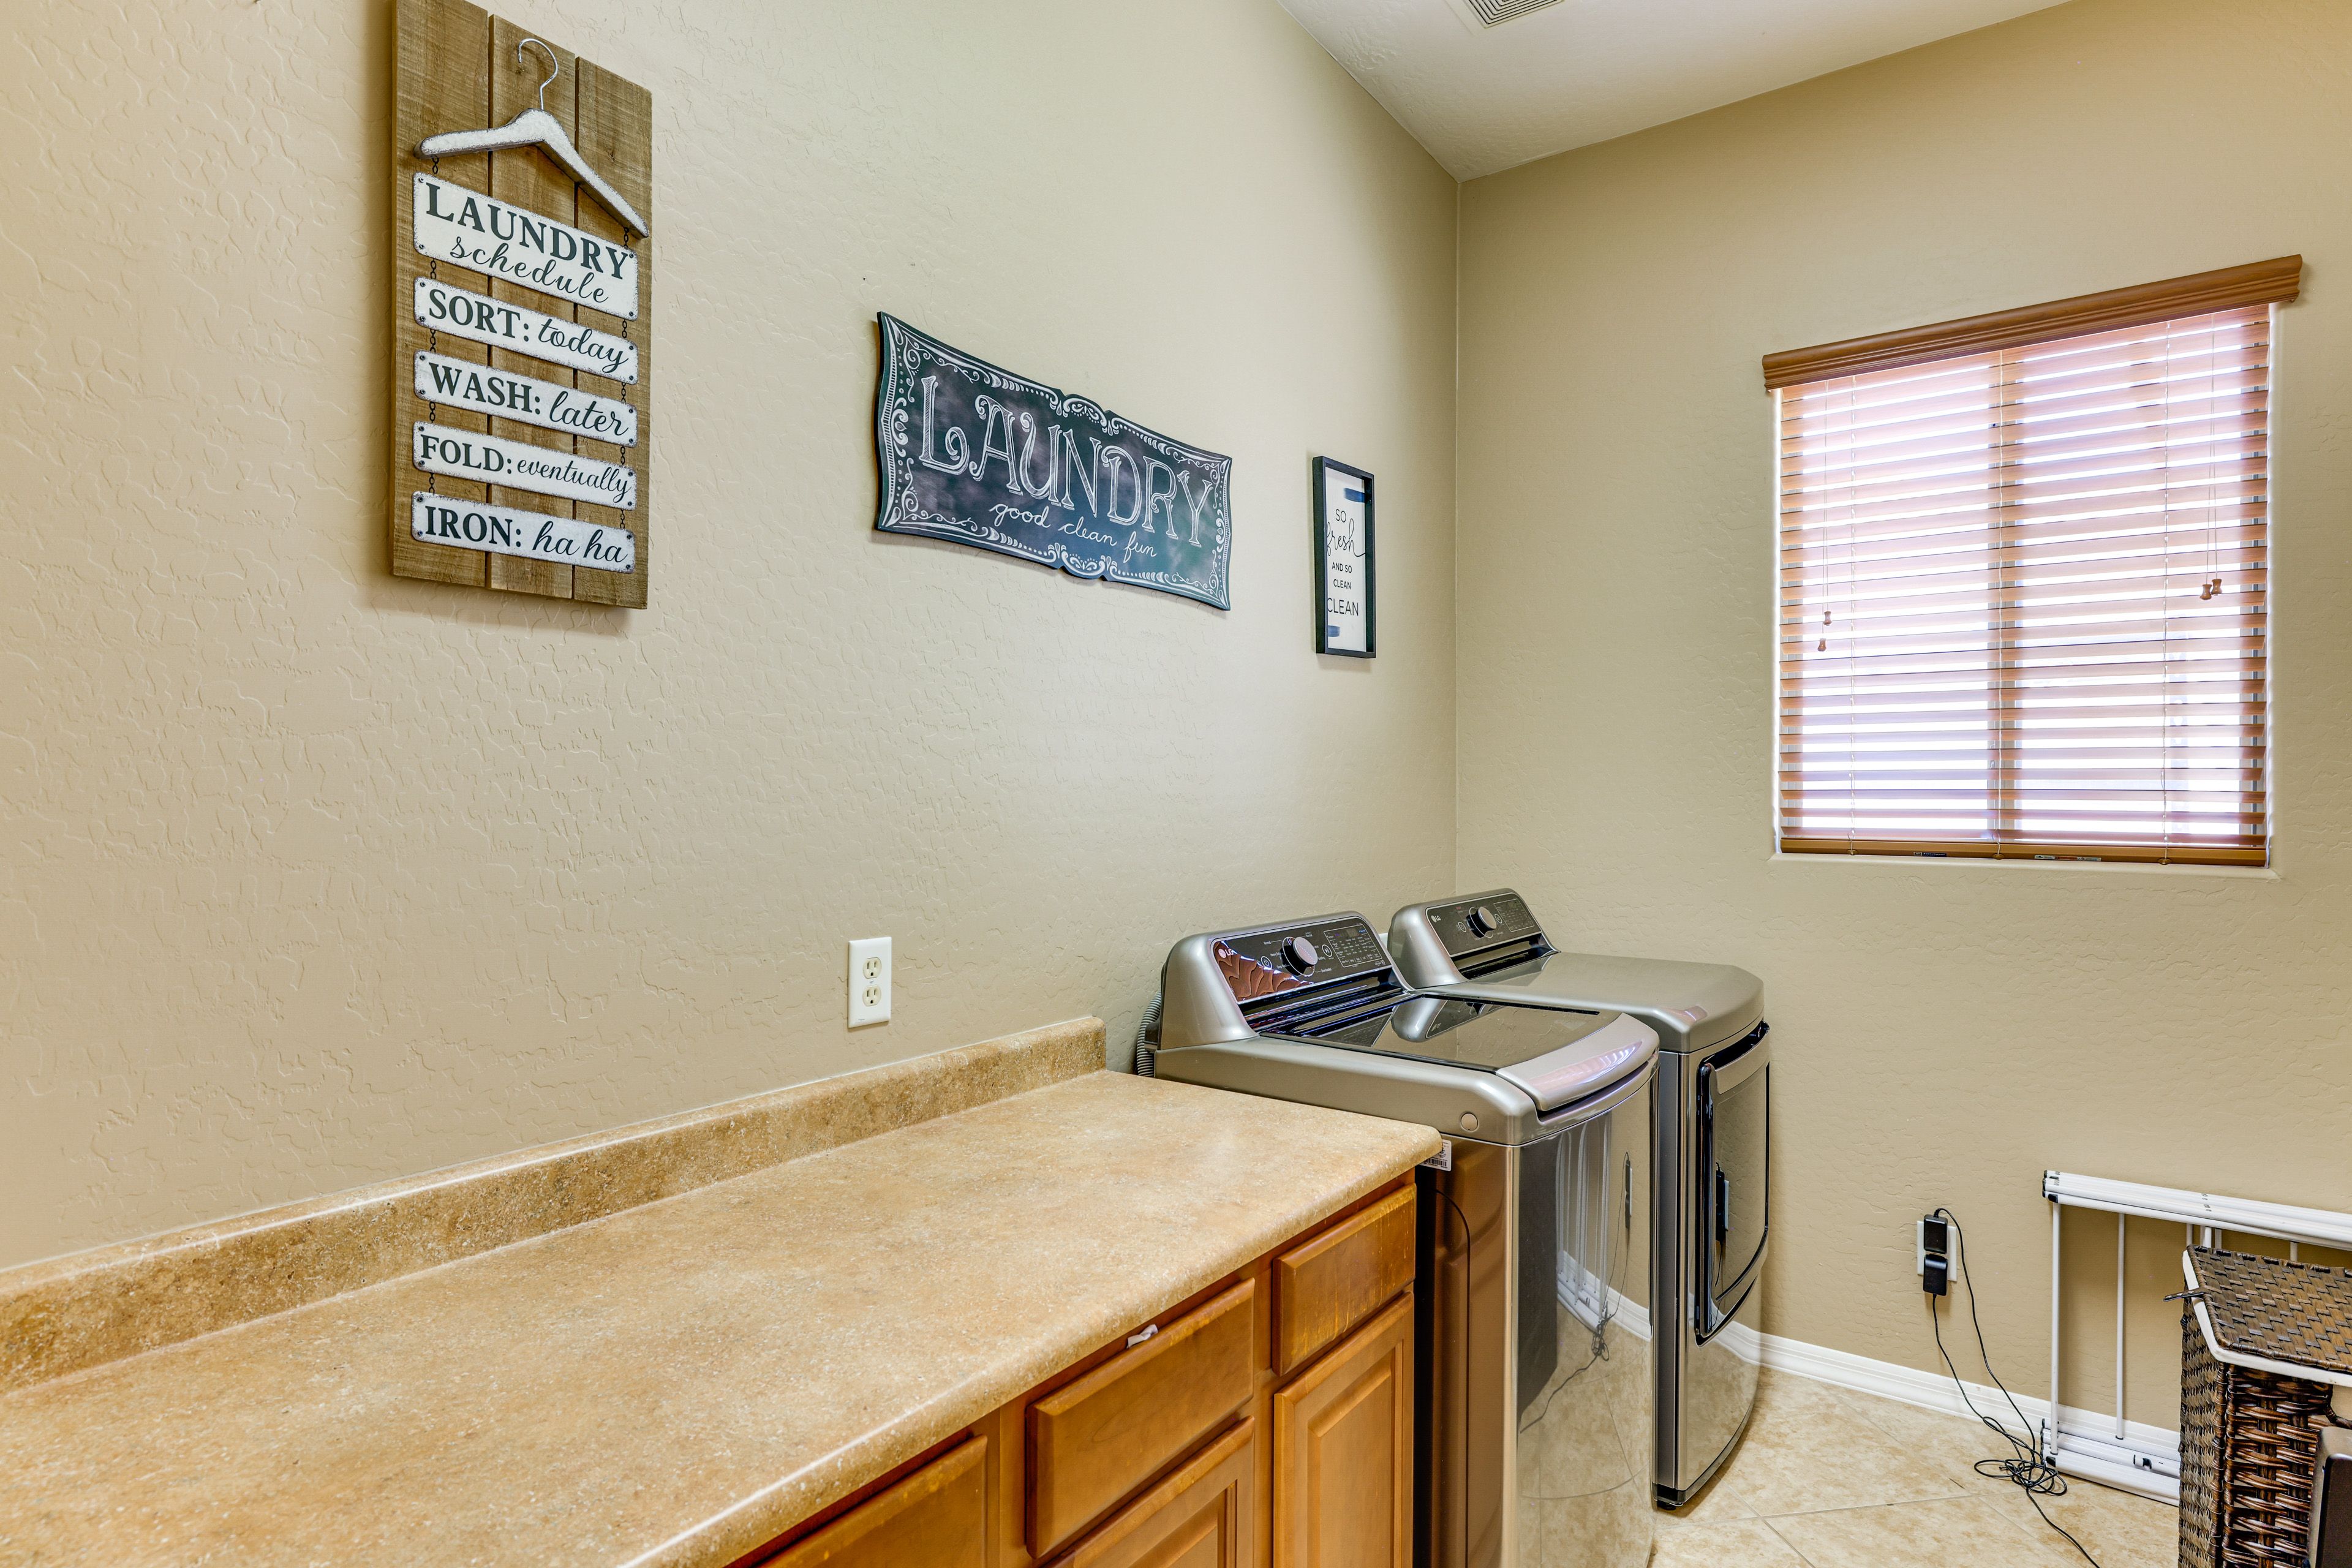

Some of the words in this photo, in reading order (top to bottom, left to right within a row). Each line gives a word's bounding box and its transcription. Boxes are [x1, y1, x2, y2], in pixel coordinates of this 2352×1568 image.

[426, 182, 628, 279] LAUNDRY
[450, 236, 609, 303] schedule
[429, 288, 530, 342] SORT:
[538, 318, 629, 373] today
[429, 362, 540, 415] WASH:
[549, 391, 629, 436] later
[420, 434, 512, 474] FOLD:
[517, 456, 631, 503] eventually
[919, 375, 1213, 548] LAUNDRY
[425, 505, 521, 548] IRON:
[533, 521, 581, 556] ha
[583, 529, 628, 564] ha
[989, 503, 1051, 529] good
[1058, 517, 1117, 546] clean
[1123, 532, 1157, 564] fun
[1327, 518, 1366, 557] fresh
[1335, 509, 1347, 522] SO
[1332, 562, 1343, 573] AND
[1345, 564, 1352, 573] SO
[1333, 579, 1351, 590] CLEAN
[1327, 597, 1359, 617] CLEAN
